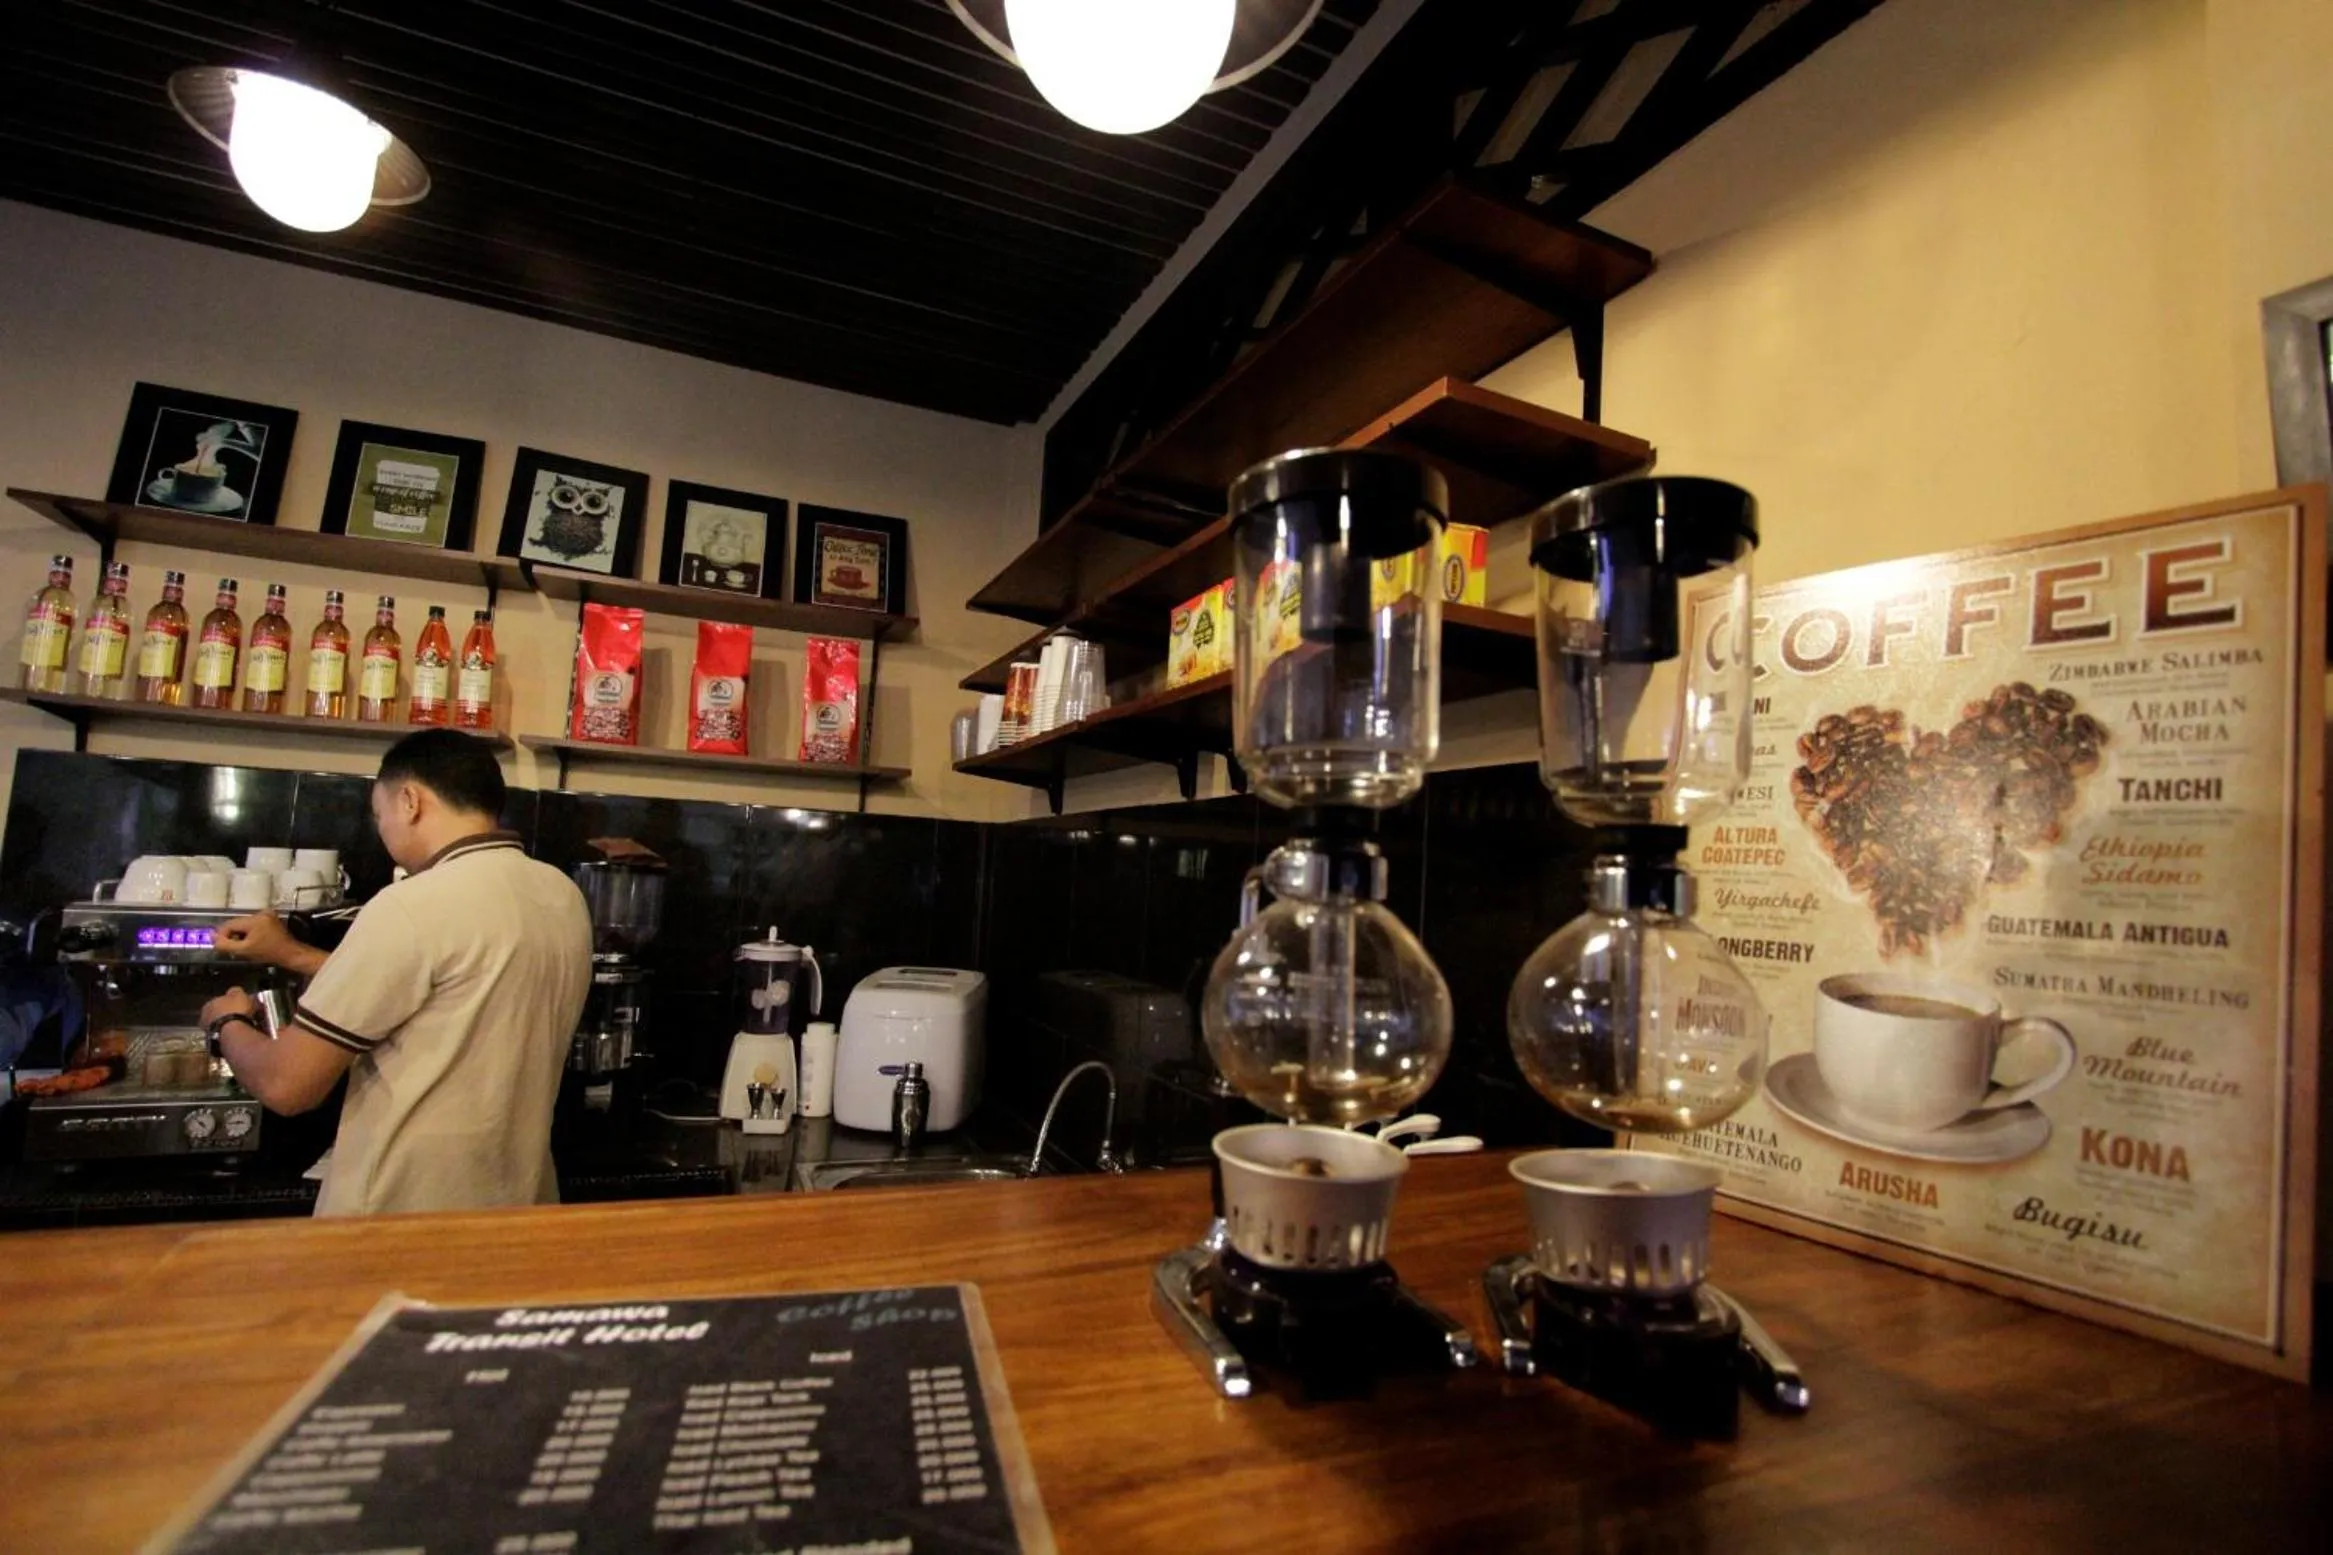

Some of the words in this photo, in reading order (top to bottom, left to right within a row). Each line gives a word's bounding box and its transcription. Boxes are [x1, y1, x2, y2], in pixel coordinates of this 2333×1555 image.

[1705, 536, 2240, 681] COFFEE
[2126, 696, 2248, 723] ARABIAN
[2139, 722, 2231, 745] MOCHA
[2117, 777, 2223, 803] TANCHI
[1713, 825, 1778, 846] ALTURA
[2080, 835, 2205, 863] Ethiopia
[2082, 862, 2205, 886] Sidamo
[1986, 915, 2114, 941] GUATEMALA
[2122, 921, 2231, 949] ANTIGUA
[1717, 936, 1815, 964] ONGBERRY
[1993, 966, 2088, 995] SUMATRA
[2098, 975, 2251, 1011] MANDHELING
[2125, 1036, 2196, 1065] Blue
[2083, 1054, 2245, 1098] Mountain
[1708, 1118, 1779, 1149] TEMALA
[2080, 1126, 2191, 1184] KONA
[1838, 1161, 1940, 1209] ARUSHA
[2013, 1196, 2148, 1249] Bugisu
[496, 1304, 670, 1327] Samawa
[425, 1326, 577, 1353] Transit
[582, 1320, 711, 1345] Hotel
